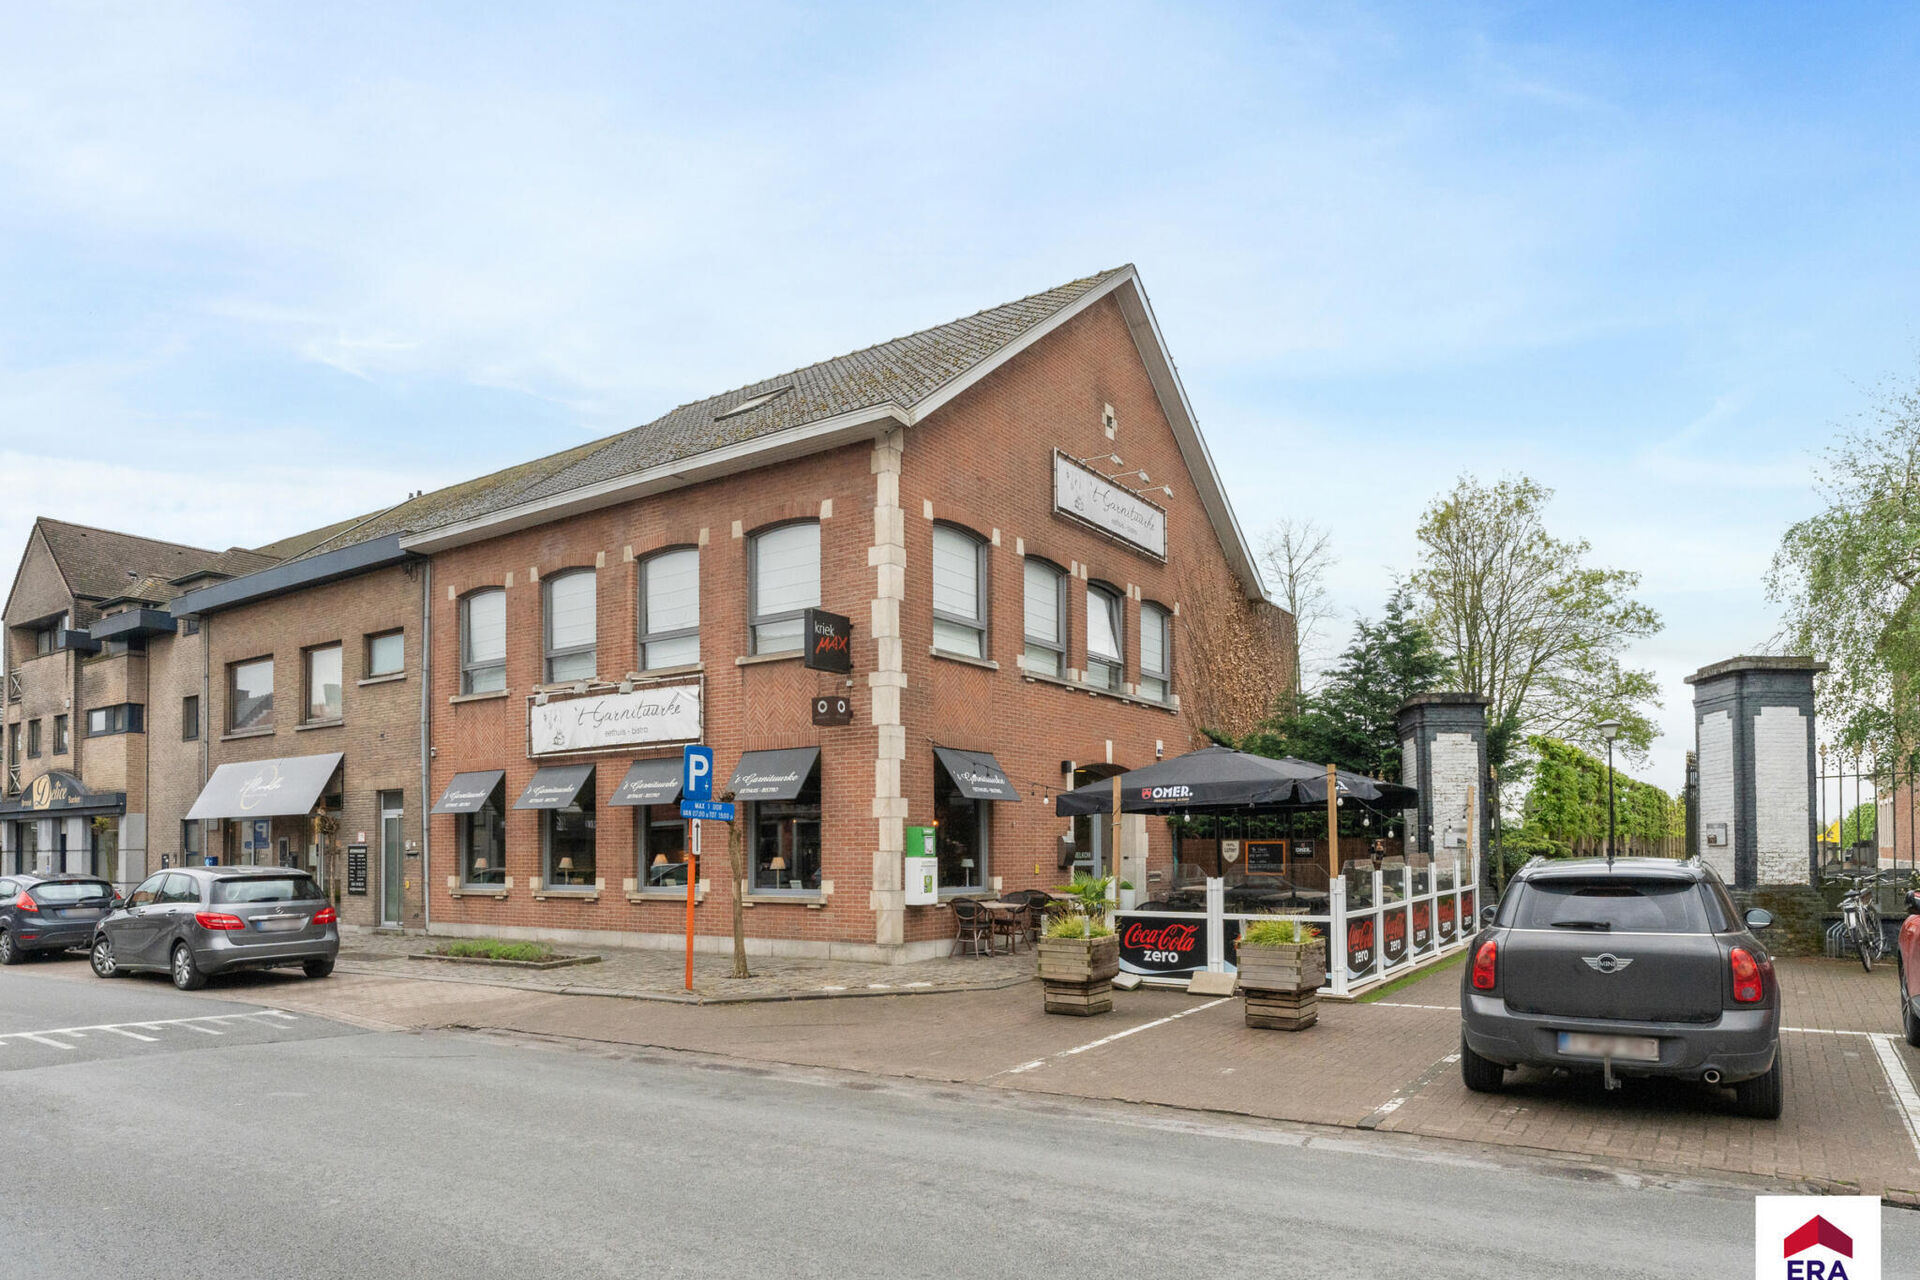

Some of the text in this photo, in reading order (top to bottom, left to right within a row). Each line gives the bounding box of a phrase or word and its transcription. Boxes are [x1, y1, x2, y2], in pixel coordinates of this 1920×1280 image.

[815, 621, 835, 637] kriek
[816, 635, 848, 654] MAX
[593, 691, 681, 728] Garnituurke
[689, 754, 709, 791] P
[1124, 922, 1199, 952] Coca-Cola
[1389, 939, 1402, 952] zero
[1143, 950, 1179, 963] zero
[1355, 949, 1369, 964] zero
